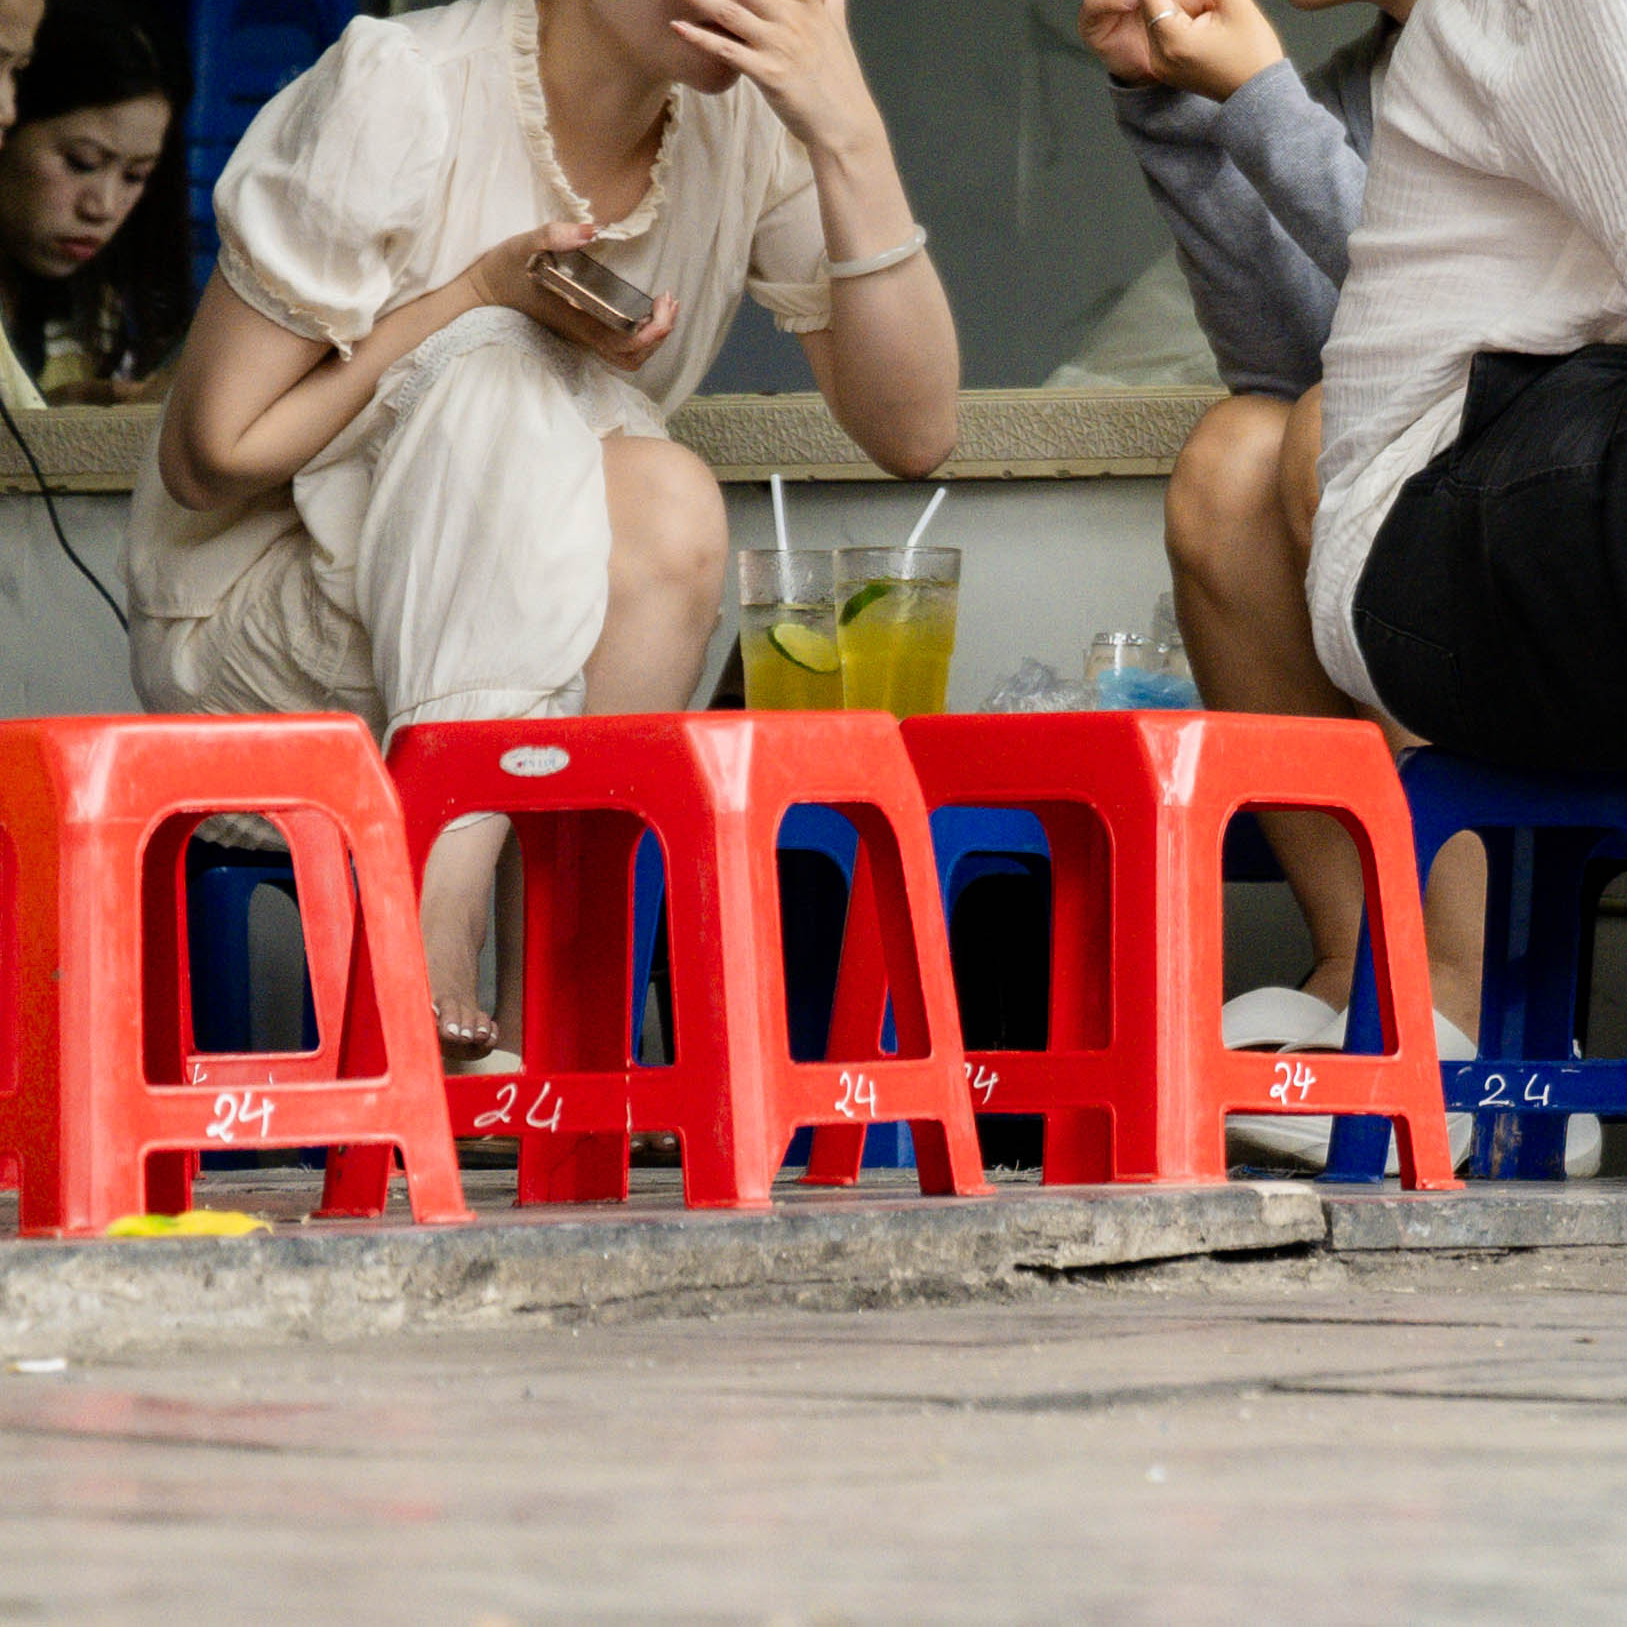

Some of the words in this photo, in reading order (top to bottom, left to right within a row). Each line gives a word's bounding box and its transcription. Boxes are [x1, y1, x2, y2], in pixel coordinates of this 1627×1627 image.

[473, 1081, 565, 1131] 24
[833, 1070, 879, 1118] 24
[1268, 1061, 1317, 1105] 24
[1478, 1072, 1551, 1108] 24
[206, 1091, 275, 1143] 24
